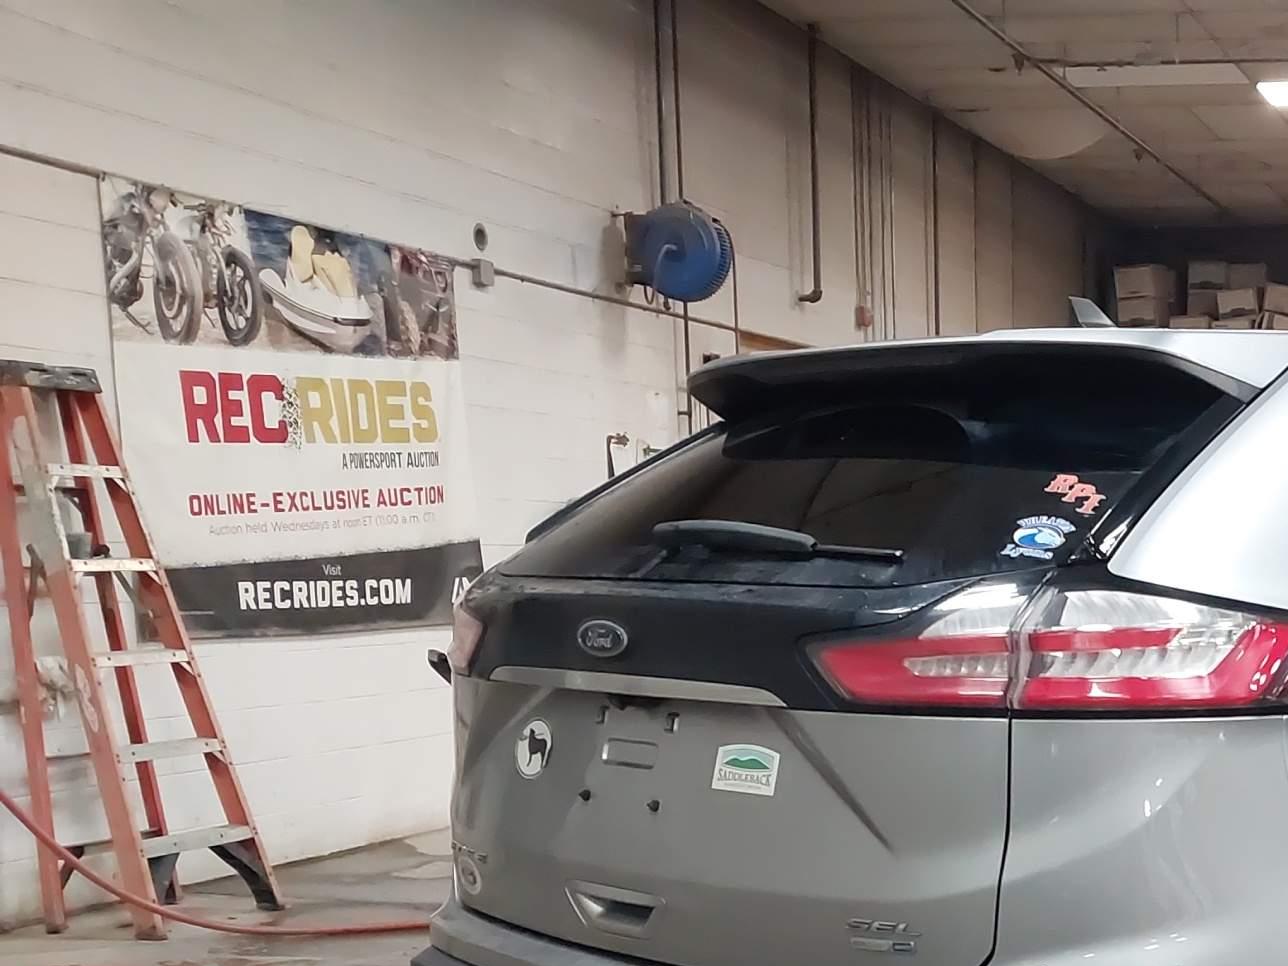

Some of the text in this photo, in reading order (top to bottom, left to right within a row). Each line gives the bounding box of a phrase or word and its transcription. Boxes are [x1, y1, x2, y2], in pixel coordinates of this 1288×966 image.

[179, 370, 440, 443] REC RIDES
[342, 451, 439, 470] A POWERSPORT AUCTION
[189, 485, 445, 517] ONLINE-EXCLUSIVE AUCTION
[209, 524, 243, 537] Auction
[245, 521, 268, 534] held
[271, 519, 330, 533] Wednesdays
[332, 519, 342, 529] at
[322, 564, 342, 576] Visit
[238, 578, 412, 611] RECRIDES.COM
[846, 918, 921, 937] SEL
